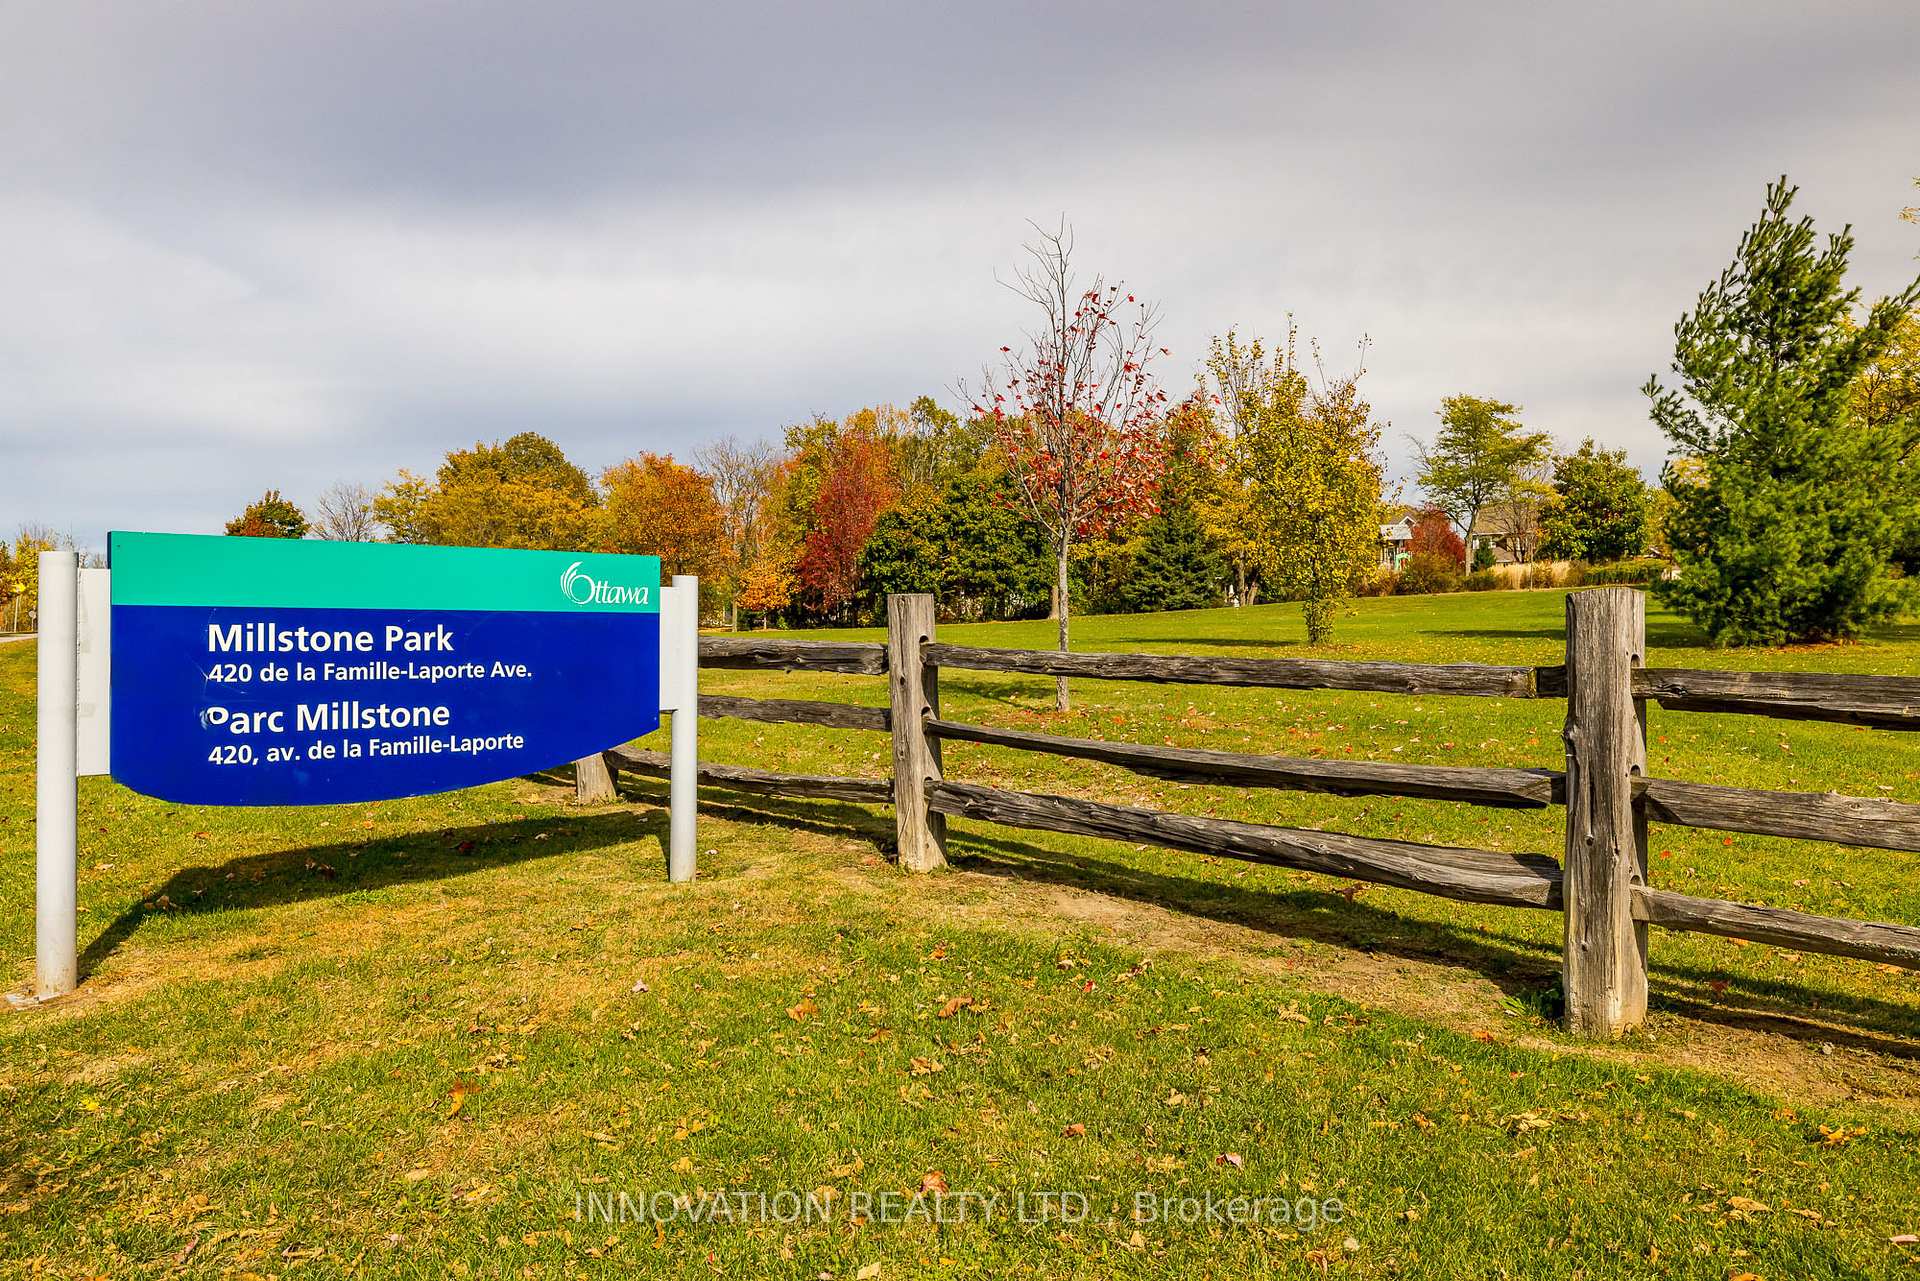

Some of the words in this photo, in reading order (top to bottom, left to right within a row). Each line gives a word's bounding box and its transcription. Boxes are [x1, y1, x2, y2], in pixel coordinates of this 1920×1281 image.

[569, 573, 649, 605] Ottawa
[208, 622, 374, 652] Millstone
[385, 623, 455, 652] Park
[208, 663, 253, 683] 420
[259, 662, 289, 682] de
[296, 662, 316, 682] la
[324, 661, 486, 684] Famille-Laporte
[490, 661, 532, 679] Ave.
[297, 700, 450, 733] Millstone
[208, 744, 259, 766] 420,
[266, 746, 301, 762] av.
[308, 740, 336, 760] de
[343, 738, 362, 758] la
[369, 733, 524, 757] Famille-Laporte
